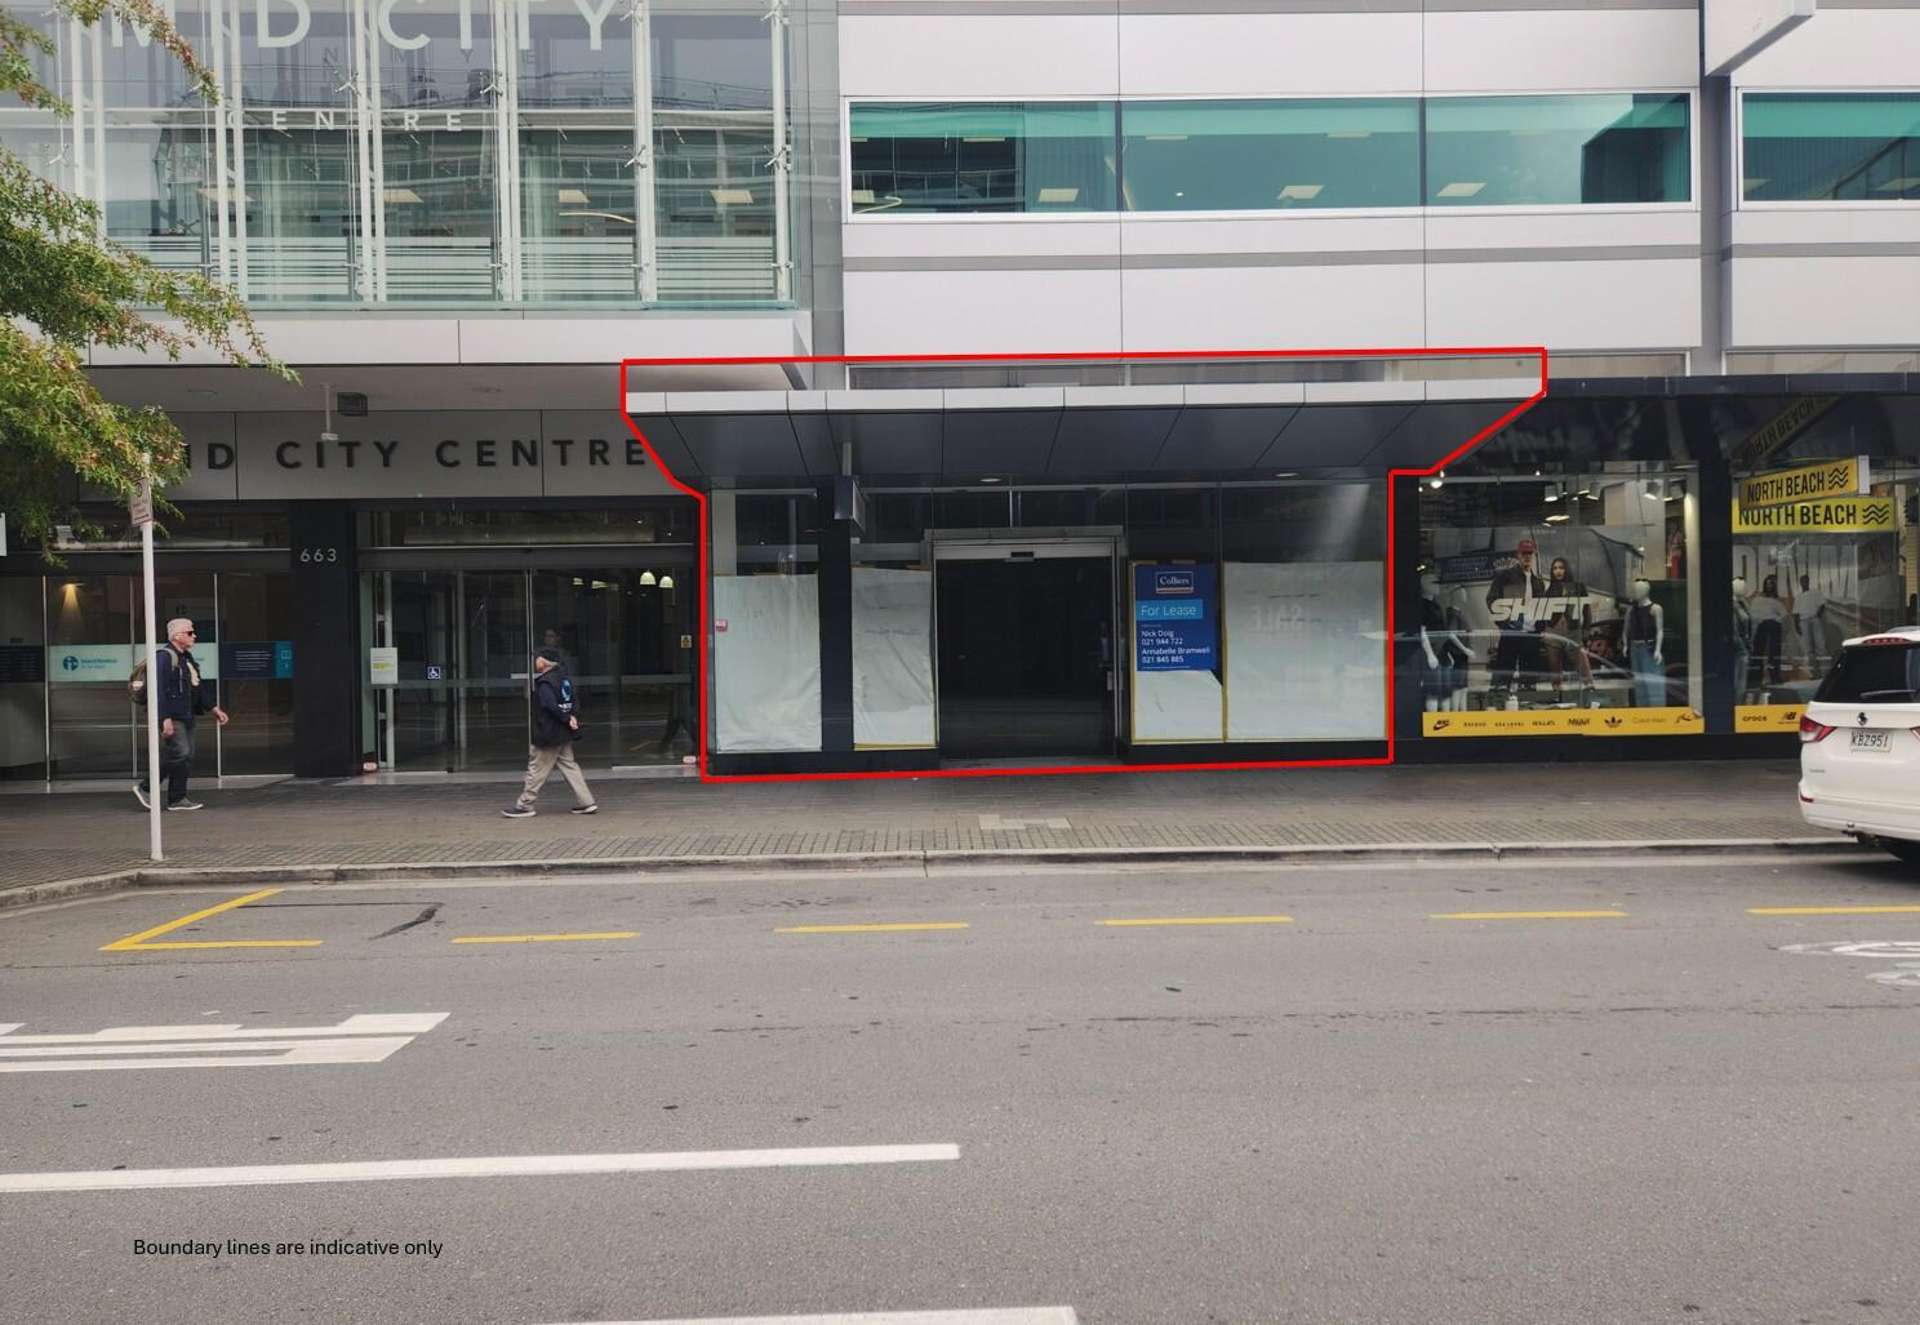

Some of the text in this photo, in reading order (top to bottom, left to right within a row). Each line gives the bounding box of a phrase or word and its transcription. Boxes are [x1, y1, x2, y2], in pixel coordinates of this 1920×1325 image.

[378, 0, 617, 51] CITY
[183, 439, 646, 470] ID CITY CENTRE
[1747, 471, 1825, 504] NORTH BEACH
[1739, 503, 1857, 526] NORTH BEACH
[300, 548, 337, 563] 663
[1160, 575, 1190, 585] Colliers
[1141, 605, 1197, 617] For Lease
[1490, 597, 1595, 622] SHIFT
[1141, 630, 1156, 638] Nick
[1141, 638, 1154, 646] 021
[1141, 647, 1176, 655] Annabelle
[1141, 656, 1154, 664] 021
